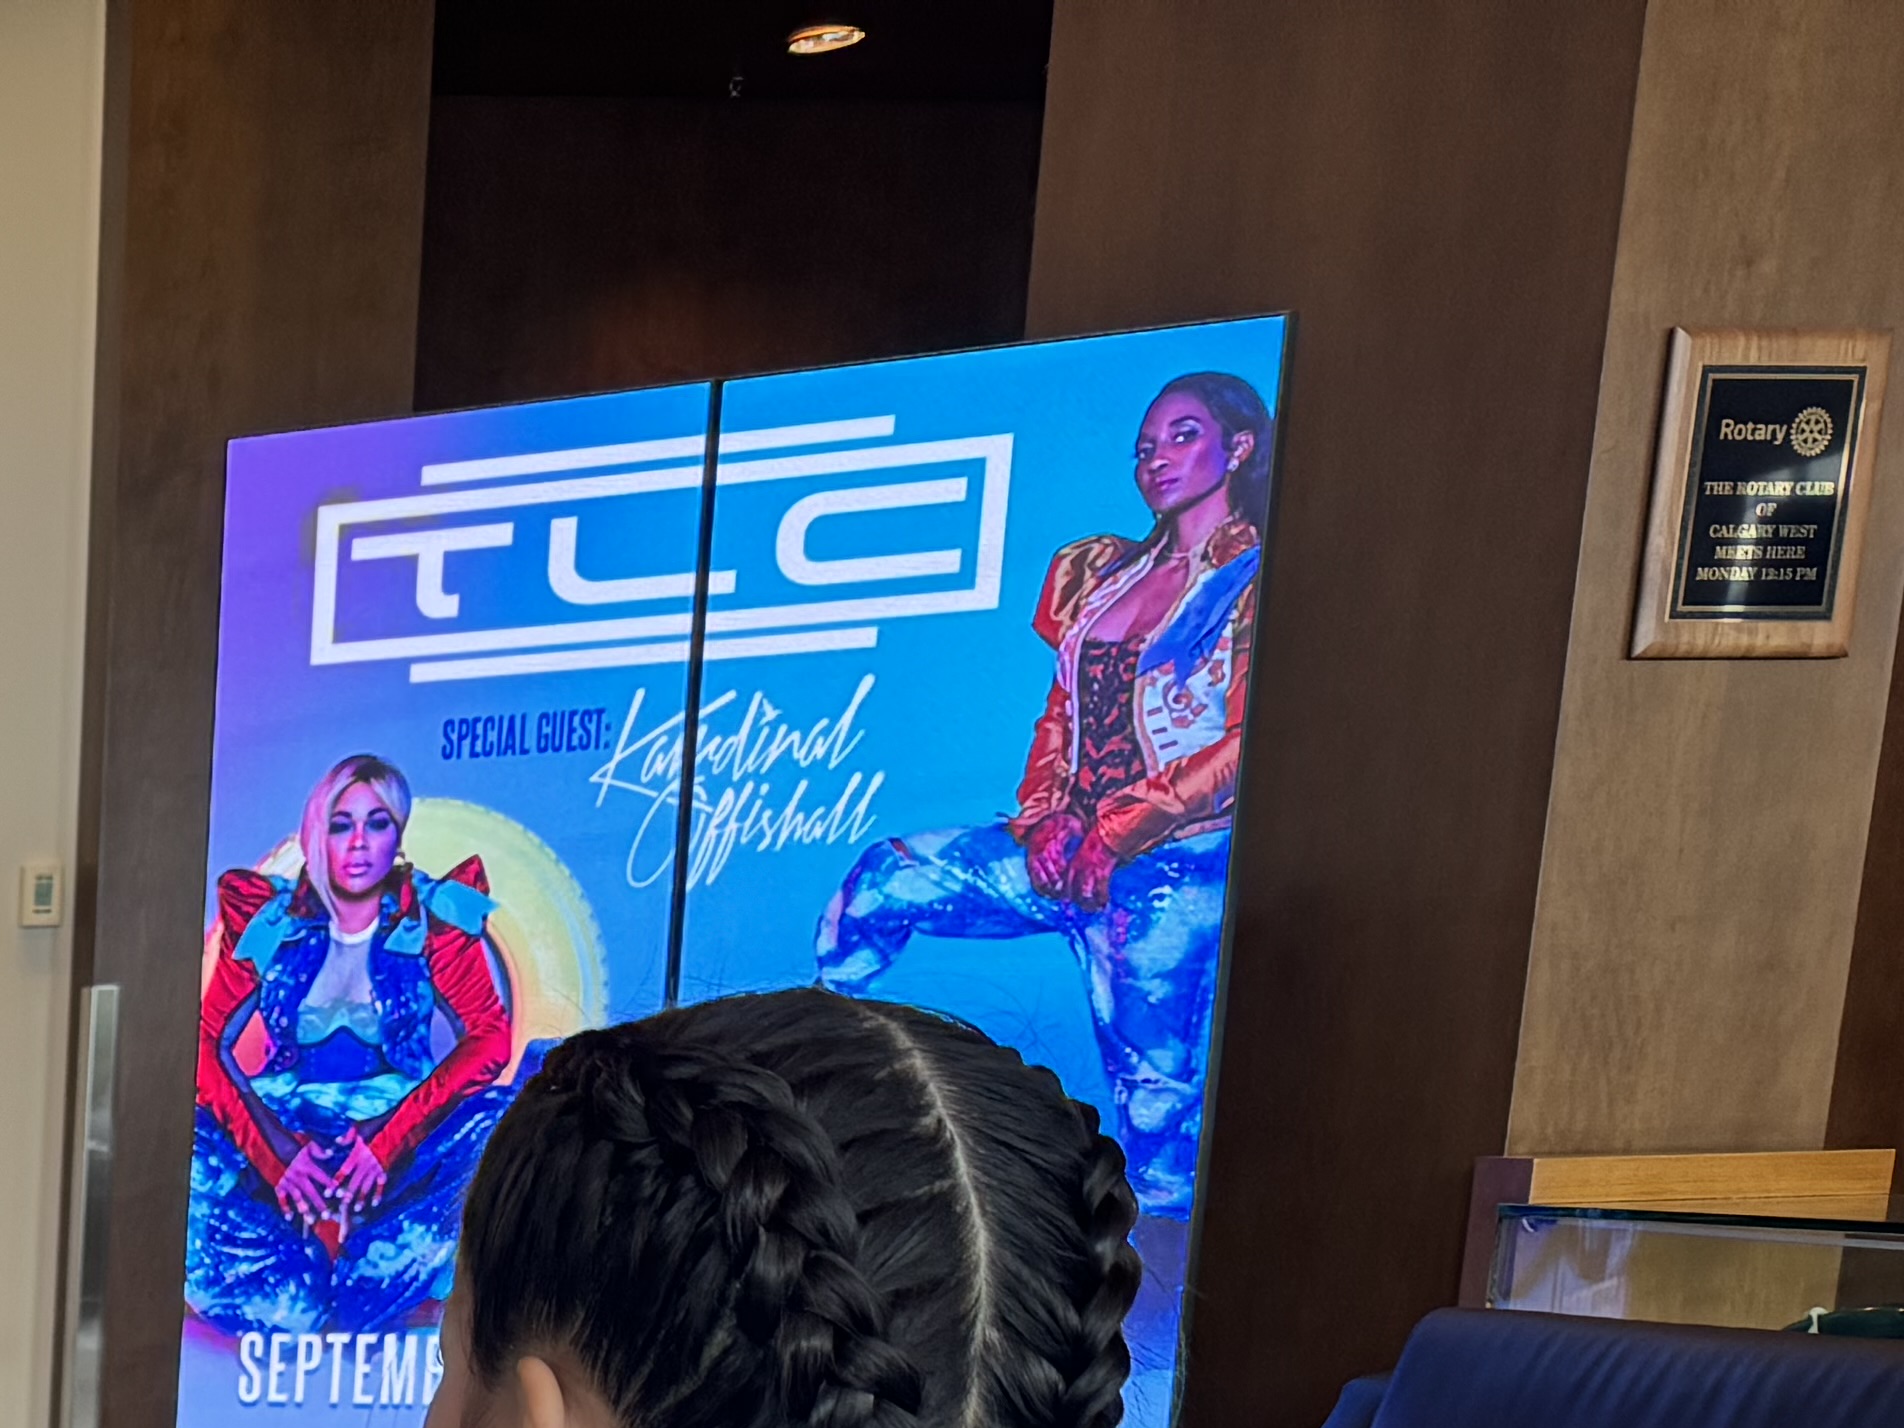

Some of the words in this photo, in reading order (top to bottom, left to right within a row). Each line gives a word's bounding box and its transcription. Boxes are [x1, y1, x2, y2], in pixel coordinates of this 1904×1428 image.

[1719, 418, 1788, 445] Rotary
[1704, 481, 1734, 495] THE
[1736, 481, 1793, 496] ROTARY
[1795, 481, 1835, 496] CLUB
[1755, 502, 1777, 517] OF
[1709, 524, 1776, 538] CALGARY
[1778, 524, 1818, 538] WEST
[351, 476, 969, 619] TLC
[1714, 545, 1763, 560] MEETS
[1765, 545, 1806, 560] HERE
[1695, 566, 1758, 581] MONDAY
[1795, 566, 1818, 581] PM
[441, 713, 530, 761] SPECIAL
[536, 707, 613, 754] GUEST:
